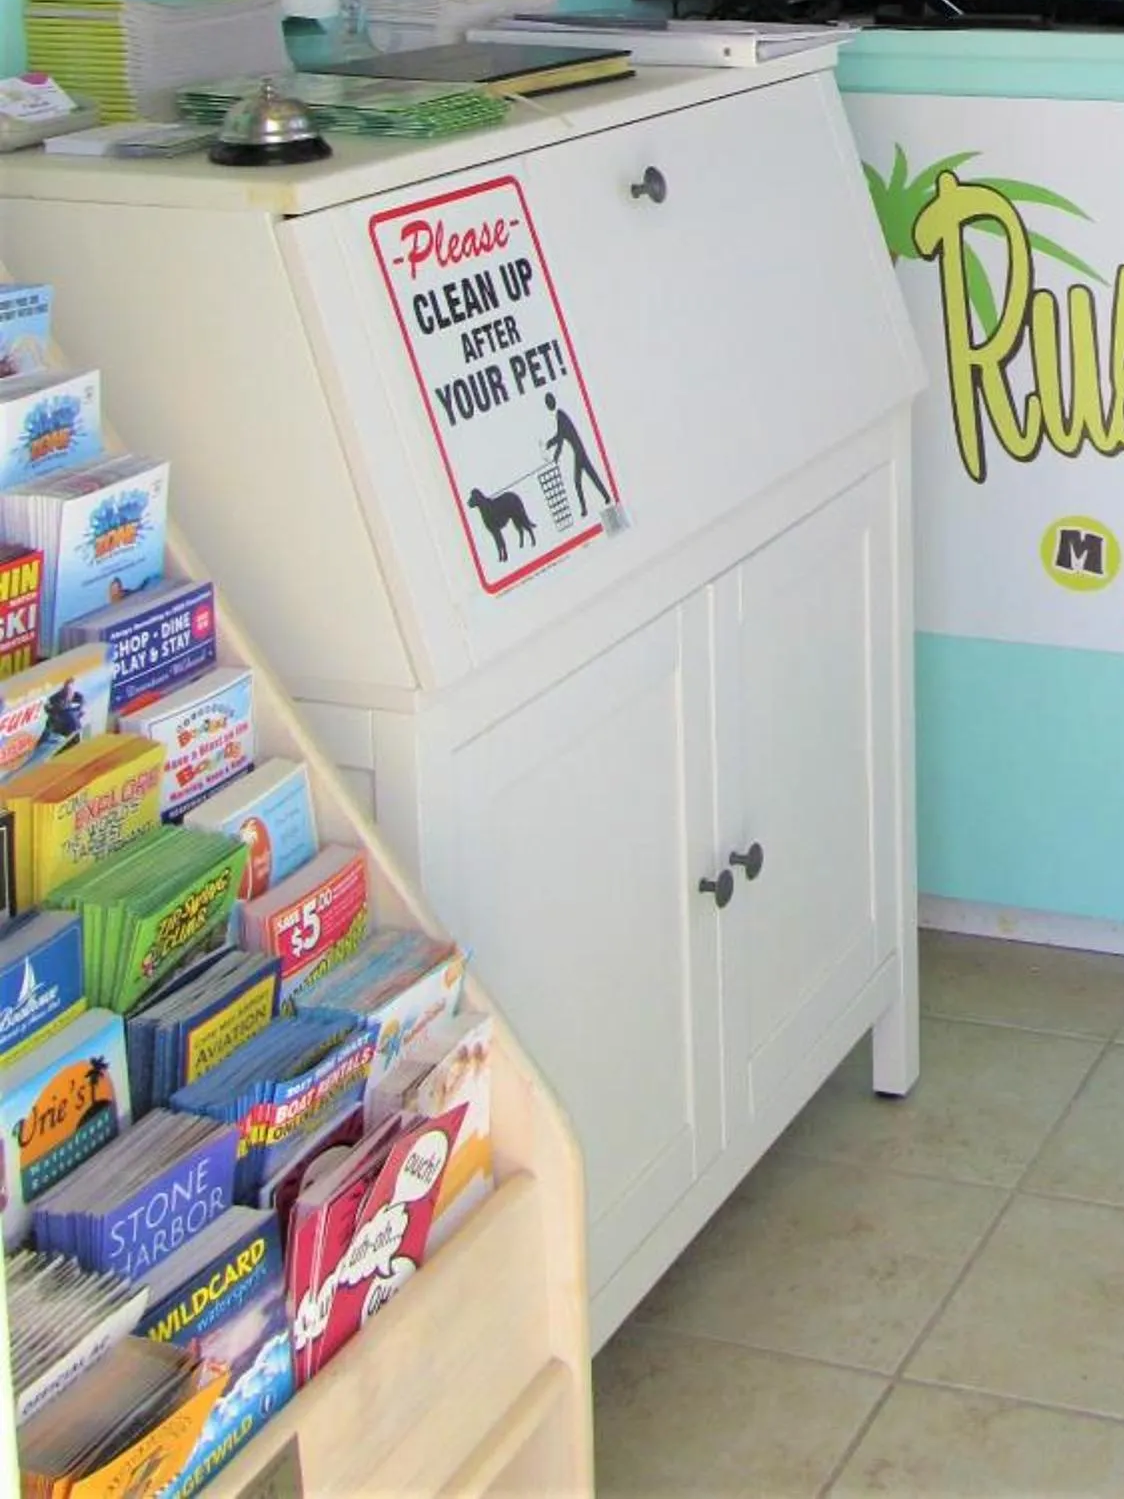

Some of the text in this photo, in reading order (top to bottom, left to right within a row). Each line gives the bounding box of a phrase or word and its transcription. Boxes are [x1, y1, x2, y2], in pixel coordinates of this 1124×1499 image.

[413, 257, 534, 336] CLEAN UP
[460, 314, 522, 364] AFTER
[435, 339, 568, 427] YOUR PET!
[111, 611, 191, 662] SHOP DINE
[113, 651, 147, 679] PLAY
[161, 630, 191, 657] STAY
[12, 1078, 86, 1149] Urie's
[110, 1157, 211, 1258] STONE
[148, 1237, 266, 1343] WILDCARD
